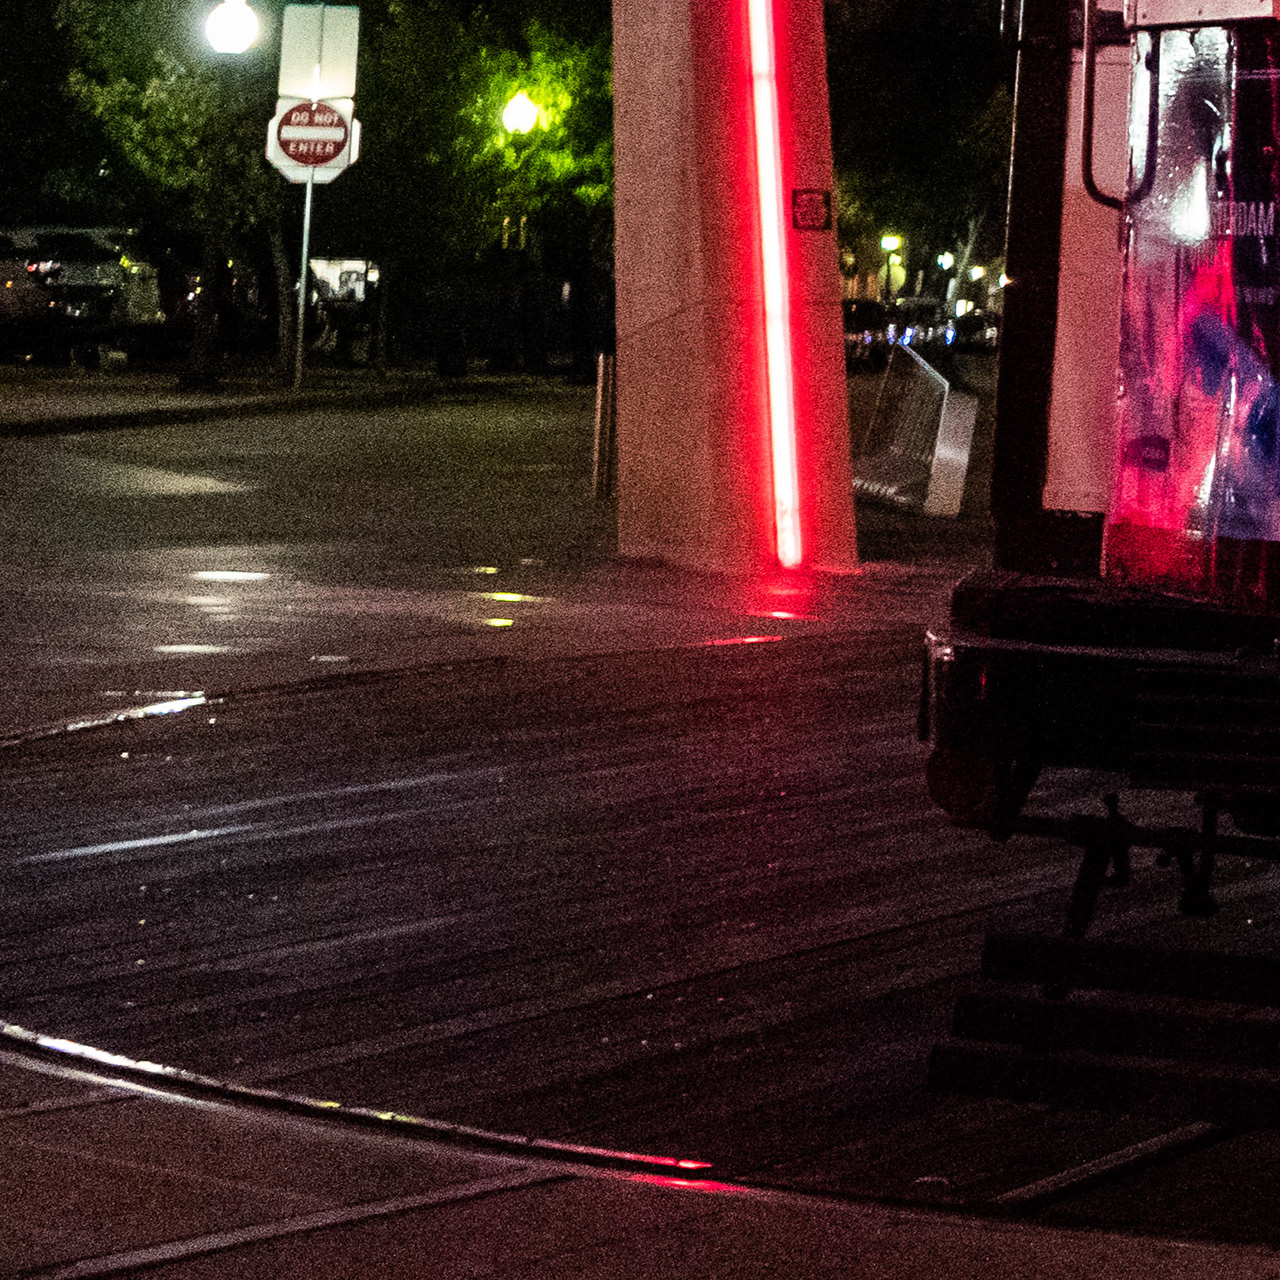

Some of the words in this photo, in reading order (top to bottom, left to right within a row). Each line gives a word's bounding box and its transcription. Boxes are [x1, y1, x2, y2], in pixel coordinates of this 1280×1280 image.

[291, 111, 310, 125] DO
[314, 112, 340, 126] NOT
[289, 142, 335, 156] ENTER
